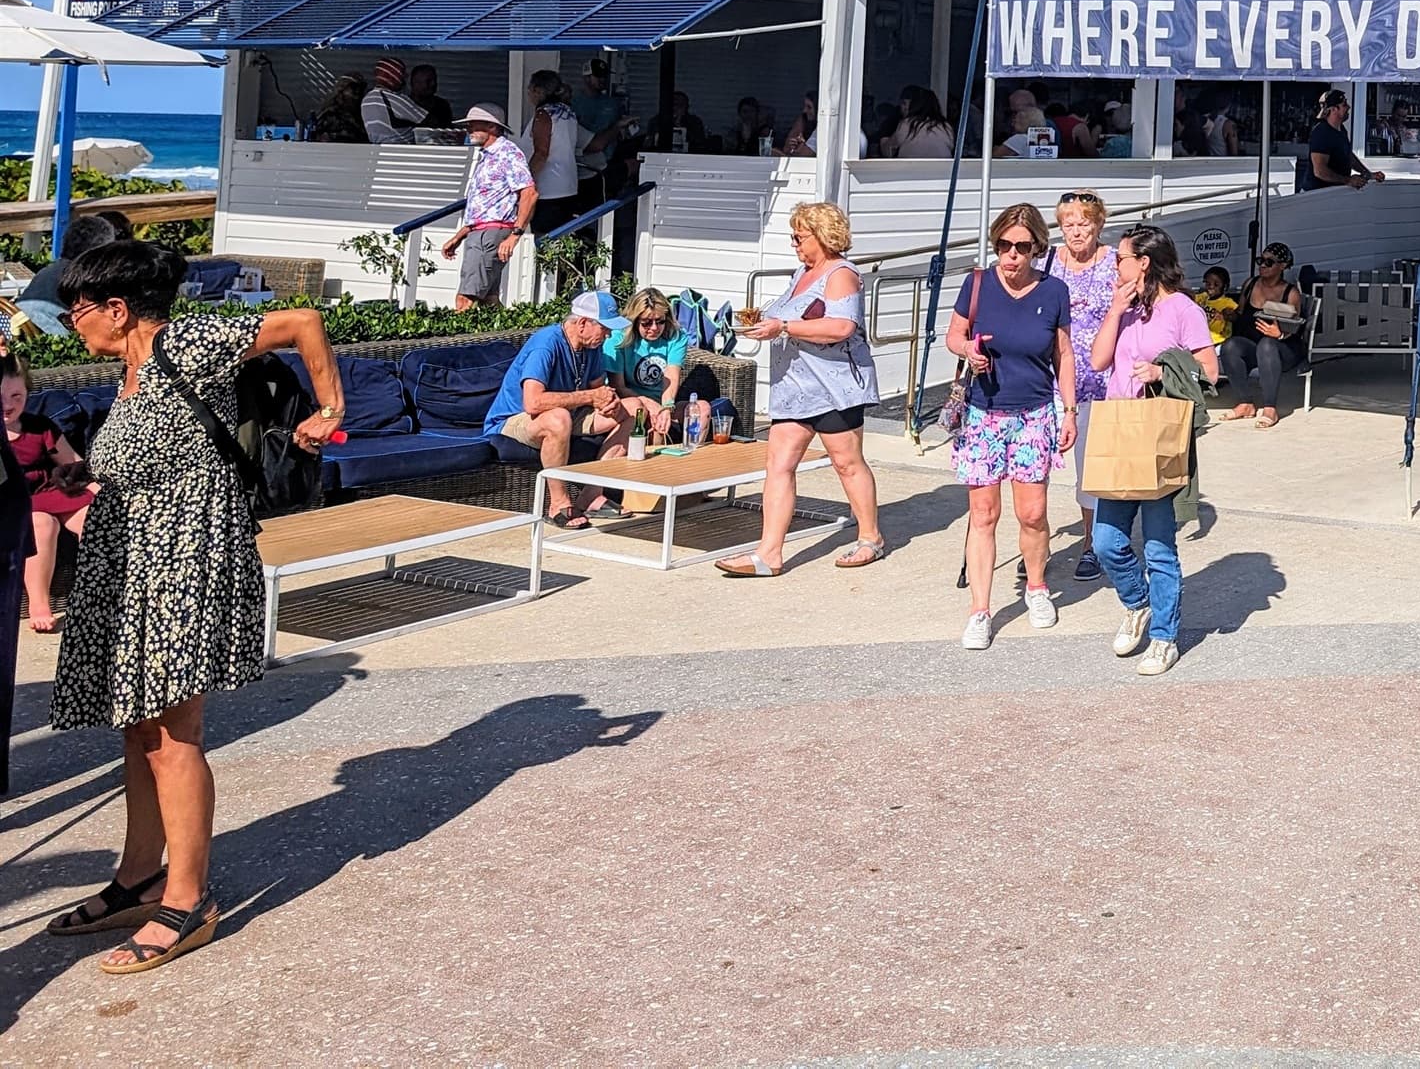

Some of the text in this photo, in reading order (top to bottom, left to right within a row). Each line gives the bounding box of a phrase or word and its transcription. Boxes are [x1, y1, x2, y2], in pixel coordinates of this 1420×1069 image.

[70, 1, 97, 17] FISHING
[1000, 0, 1174, 68] WHERE
[1195, 0, 1373, 71] EVERY
[1203, 233, 1222, 241] PLEASE
[1196, 241, 1228, 251] DO NOT FEED
[1199, 252, 1209, 260] THE
